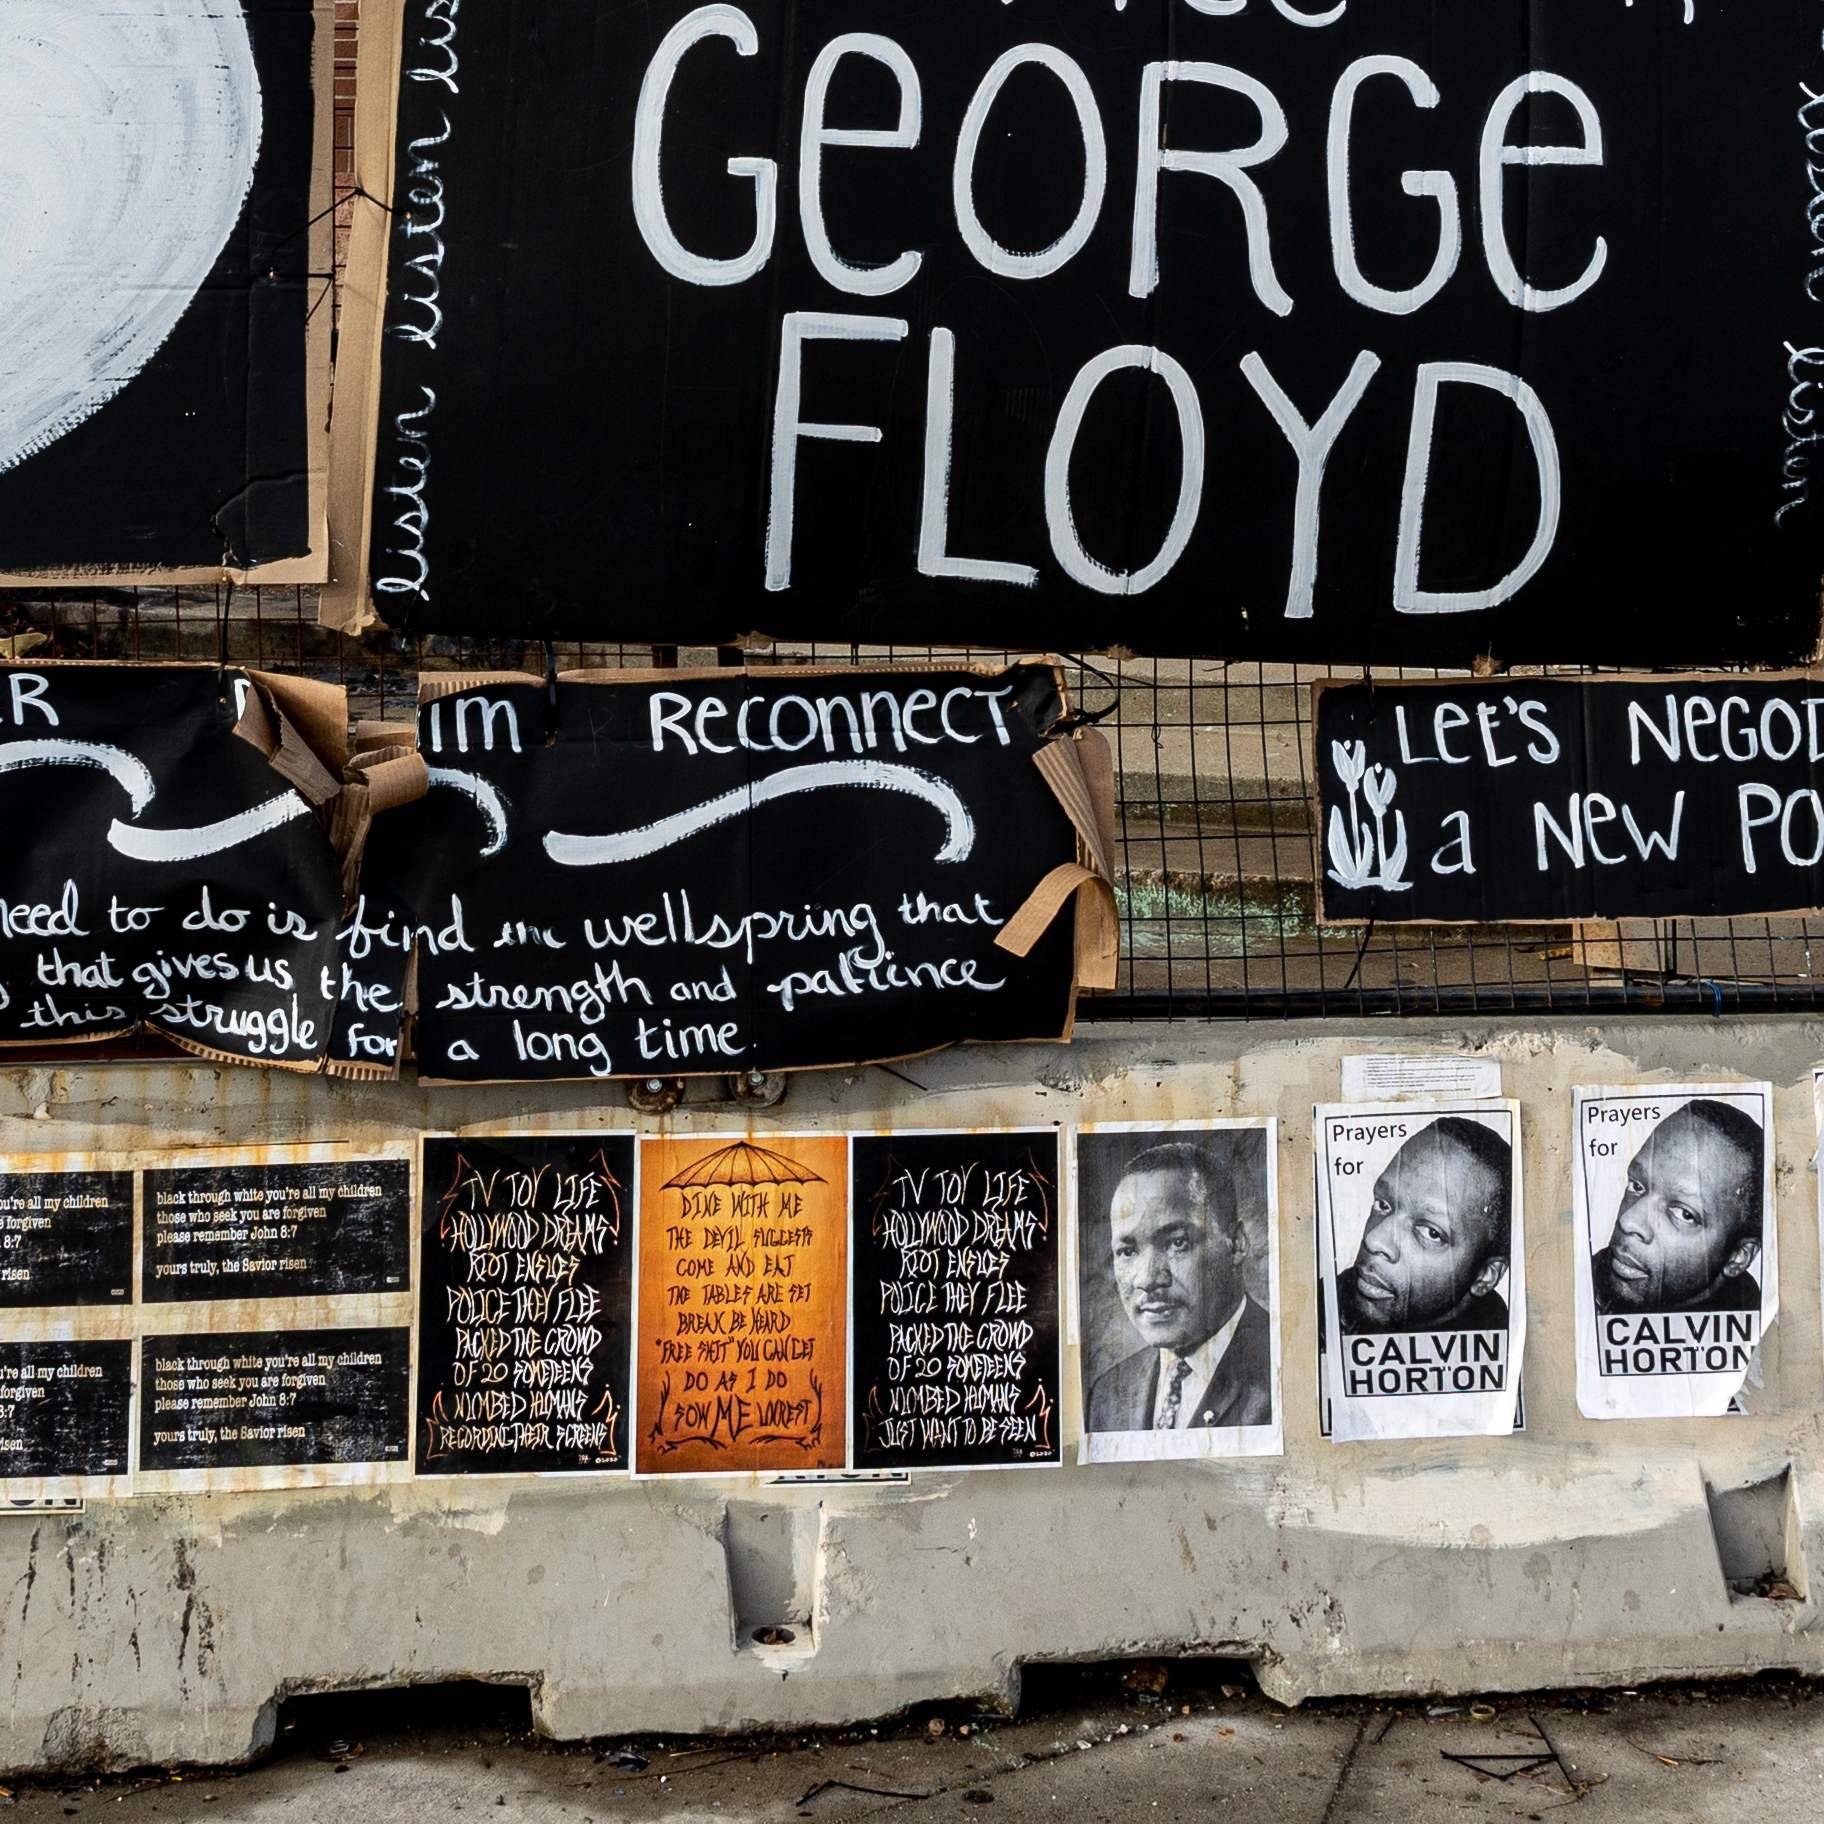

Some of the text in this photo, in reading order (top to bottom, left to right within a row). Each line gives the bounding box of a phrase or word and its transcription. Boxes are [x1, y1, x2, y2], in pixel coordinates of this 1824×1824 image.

[384, 109, 452, 350] listen
[763, 310, 1563, 620] FLOYD
[1430, 810, 1477, 875] a
[107, 894, 160, 933] to
[180, 884, 252, 935] do
[267, 901, 319, 941] is
[584, 887, 888, 969] wellspring
[897, 891, 1005, 928] that
[36, 950, 125, 990] that
[132, 948, 240, 1002] gives
[243, 953, 293, 986] us
[318, 963, 404, 1013] the
[435, 957, 654, 1026] strength
[669, 971, 737, 1004] and
[20, 997, 127, 1032] this
[148, 992, 319, 1056] struggle
[347, 1015, 399, 1058] for
[447, 1035, 480, 1062] a
[512, 1018, 615, 1078] long
[1588, 1104, 1662, 1126] Prayers
[1332, 1120, 1408, 1144] Prayers
[1589, 1137, 1619, 1158] for
[1334, 1156, 1365, 1177] for
[27, 1196, 41, 1209] all
[44, 1198, 60, 1212] my
[63, 1194, 109, 1209] children
[6, 1215, 52, 1232] forgiven
[4, 1235, 22, 1249] 8:7
[2, 1267, 30, 1281] risen
[1350, 1331, 1501, 1367] CALVIN
[1348, 1363, 1506, 1396] HORTON
